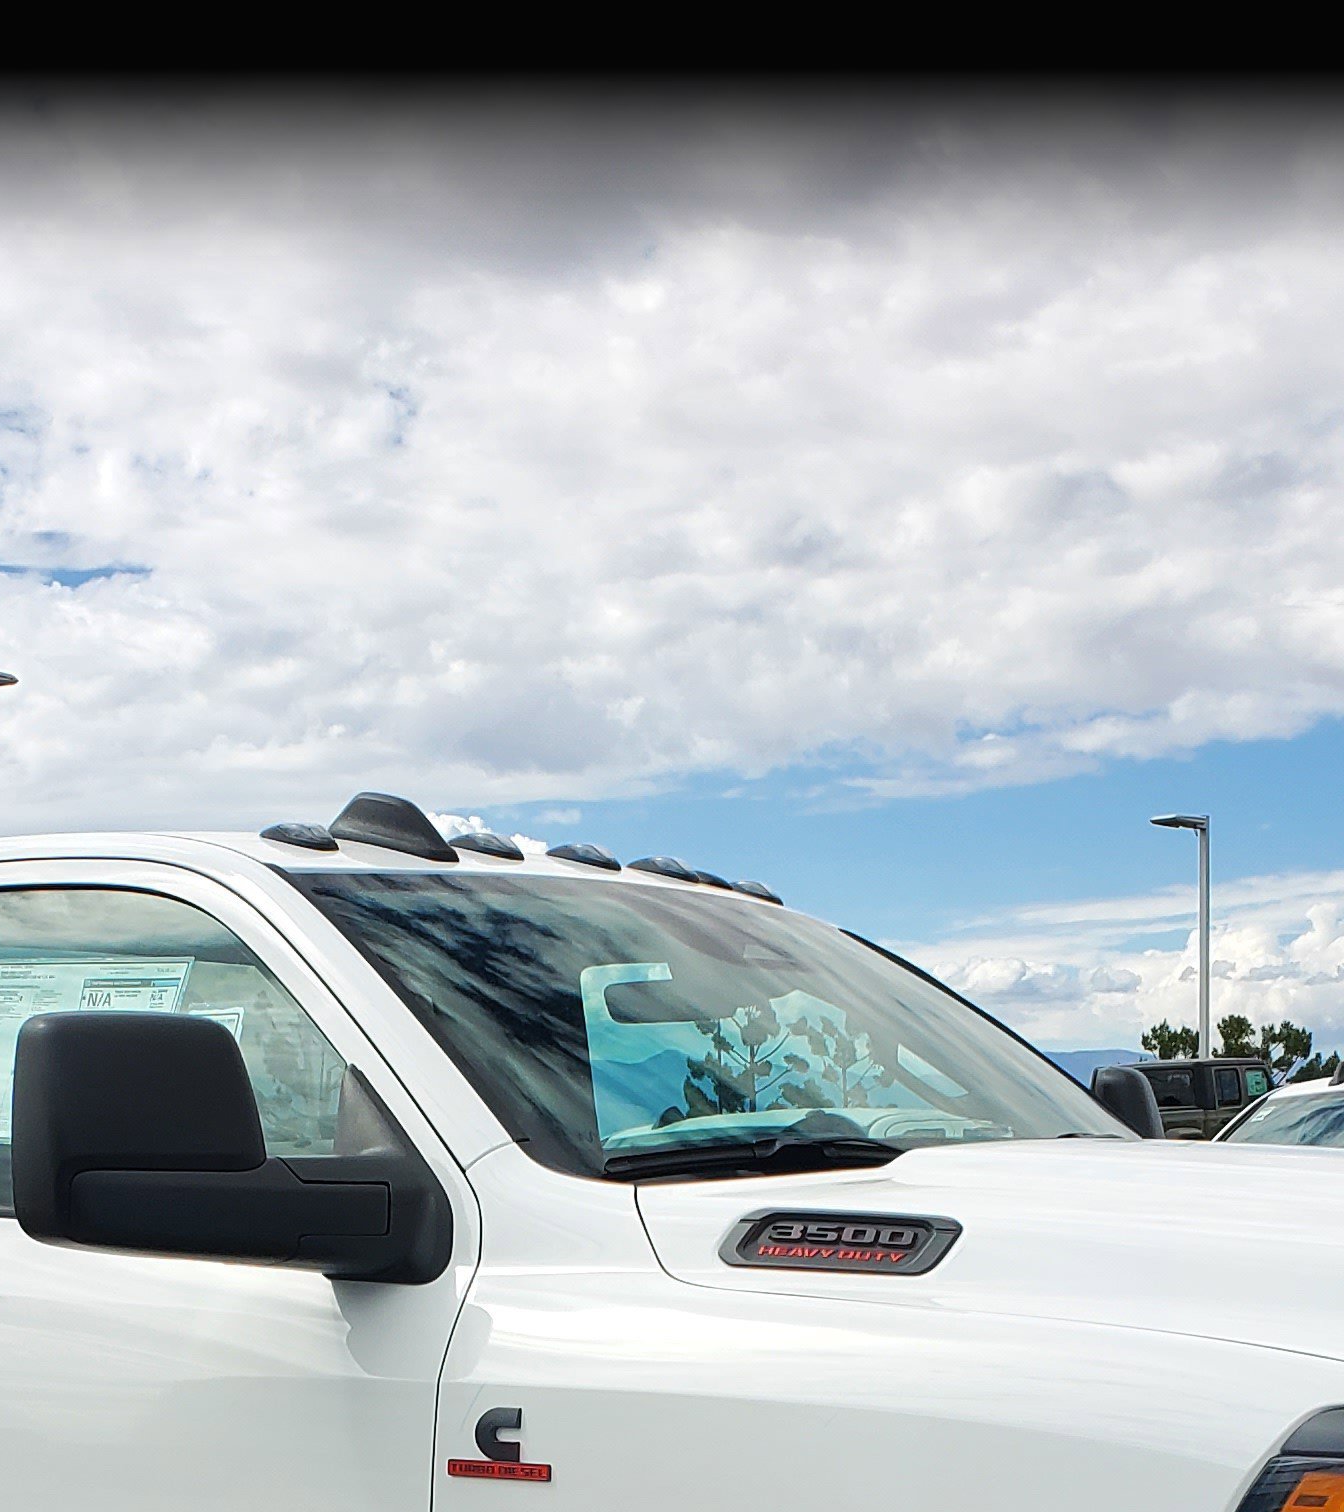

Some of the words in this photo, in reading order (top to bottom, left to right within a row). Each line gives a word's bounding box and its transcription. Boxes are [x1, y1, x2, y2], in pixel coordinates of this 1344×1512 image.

[87, 992, 112, 1007] N/A
[767, 1222, 916, 1246] 3500
[757, 1244, 830, 1259] HEAVY
[836, 1248, 908, 1263] DUTY
[498, 1466, 547, 1478] DIESEL
